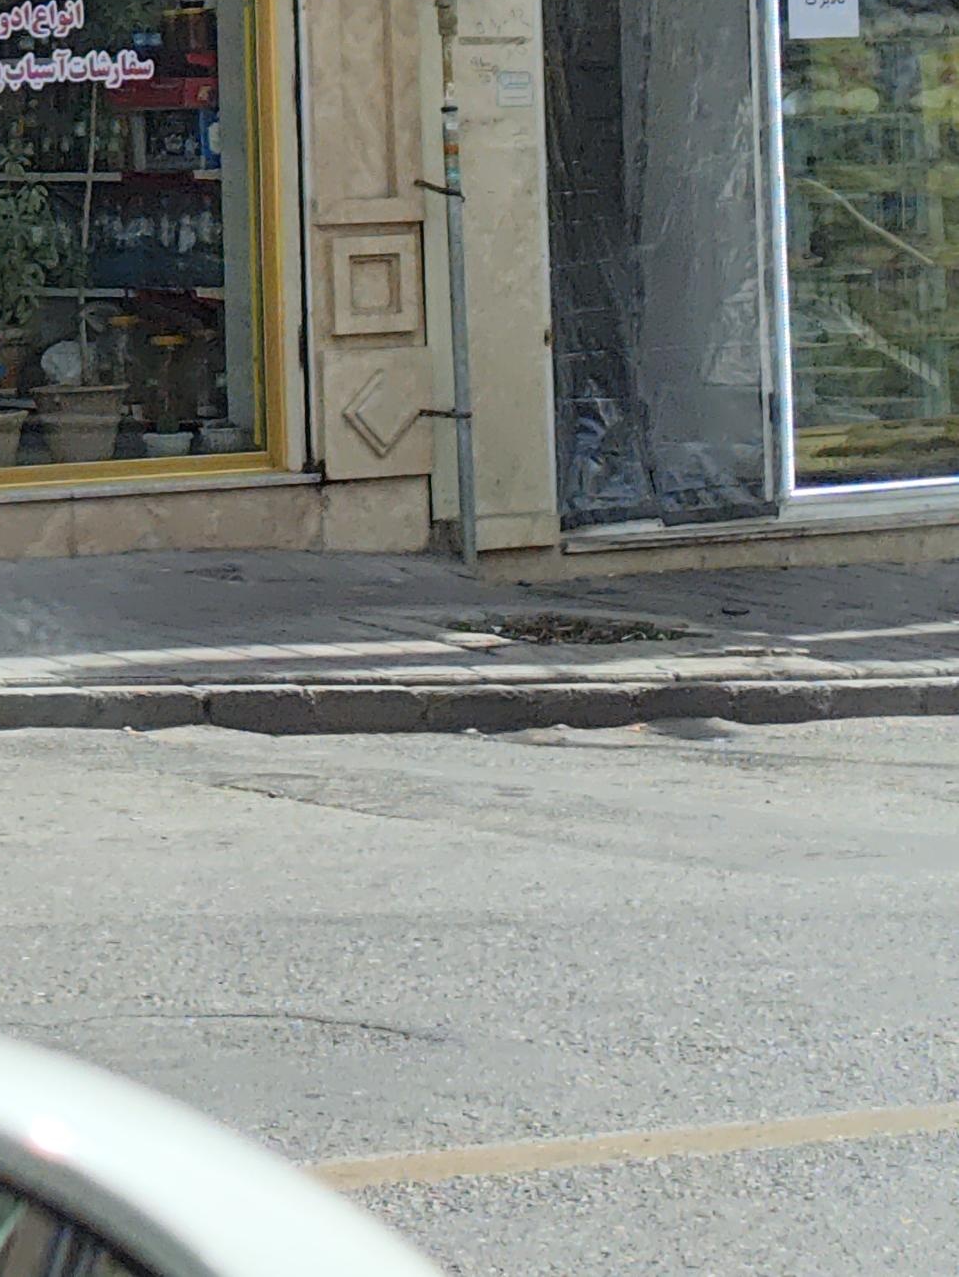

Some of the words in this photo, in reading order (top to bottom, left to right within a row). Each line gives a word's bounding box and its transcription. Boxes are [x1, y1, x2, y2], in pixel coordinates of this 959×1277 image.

[31, 0, 85, 37] انواع
[4, 49, 71, 90] آسیاب
[68, 49, 154, 89] سفارشات
